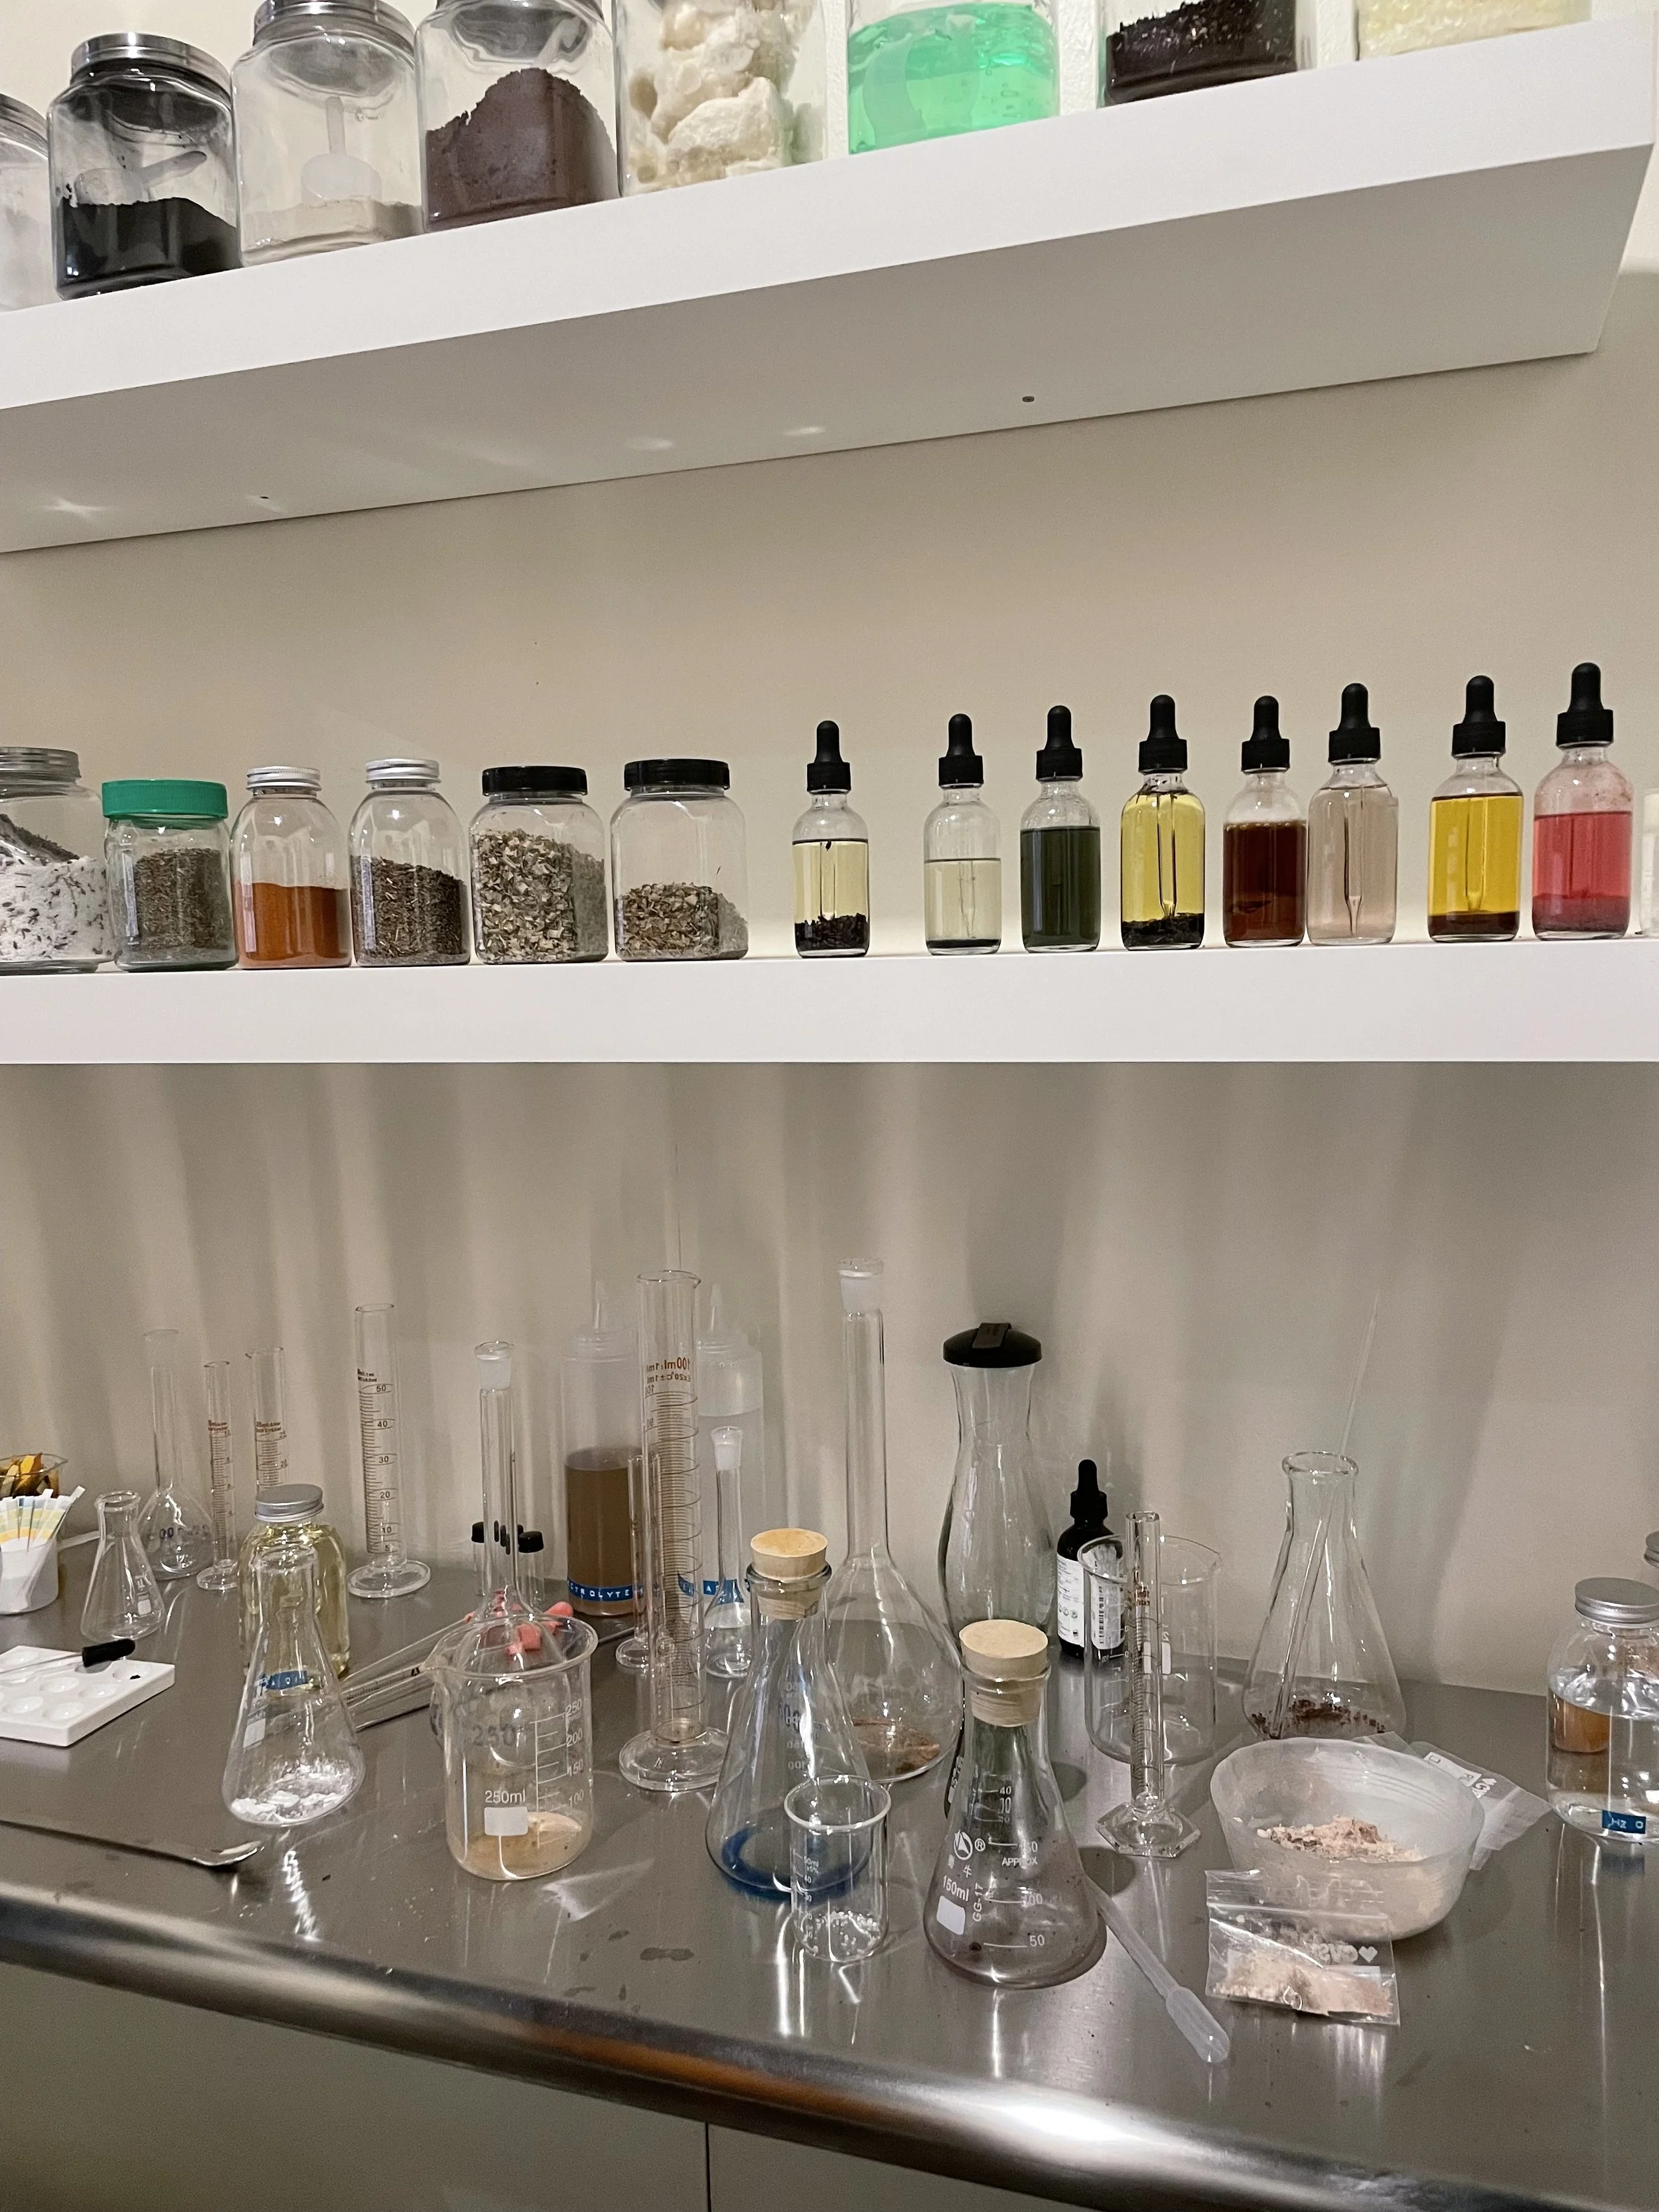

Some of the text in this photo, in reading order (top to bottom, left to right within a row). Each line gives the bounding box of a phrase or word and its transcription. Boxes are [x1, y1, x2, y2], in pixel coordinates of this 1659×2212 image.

[384, 1544, 390, 1552] 5
[567, 1580, 630, 1599] CTROLYTE
[566, 1698, 583, 1717] 250
[566, 1728, 583, 1747] 200
[567, 1759, 584, 1777] 150
[484, 1788, 526, 1804] 250ml
[568, 1789, 585, 1808] 100
[999, 1786, 1011, 1795] 40
[942, 1874, 970, 1902] 150ml
[972, 1882, 984, 1922] GG-17
[1029, 1934, 1045, 1947] 50
